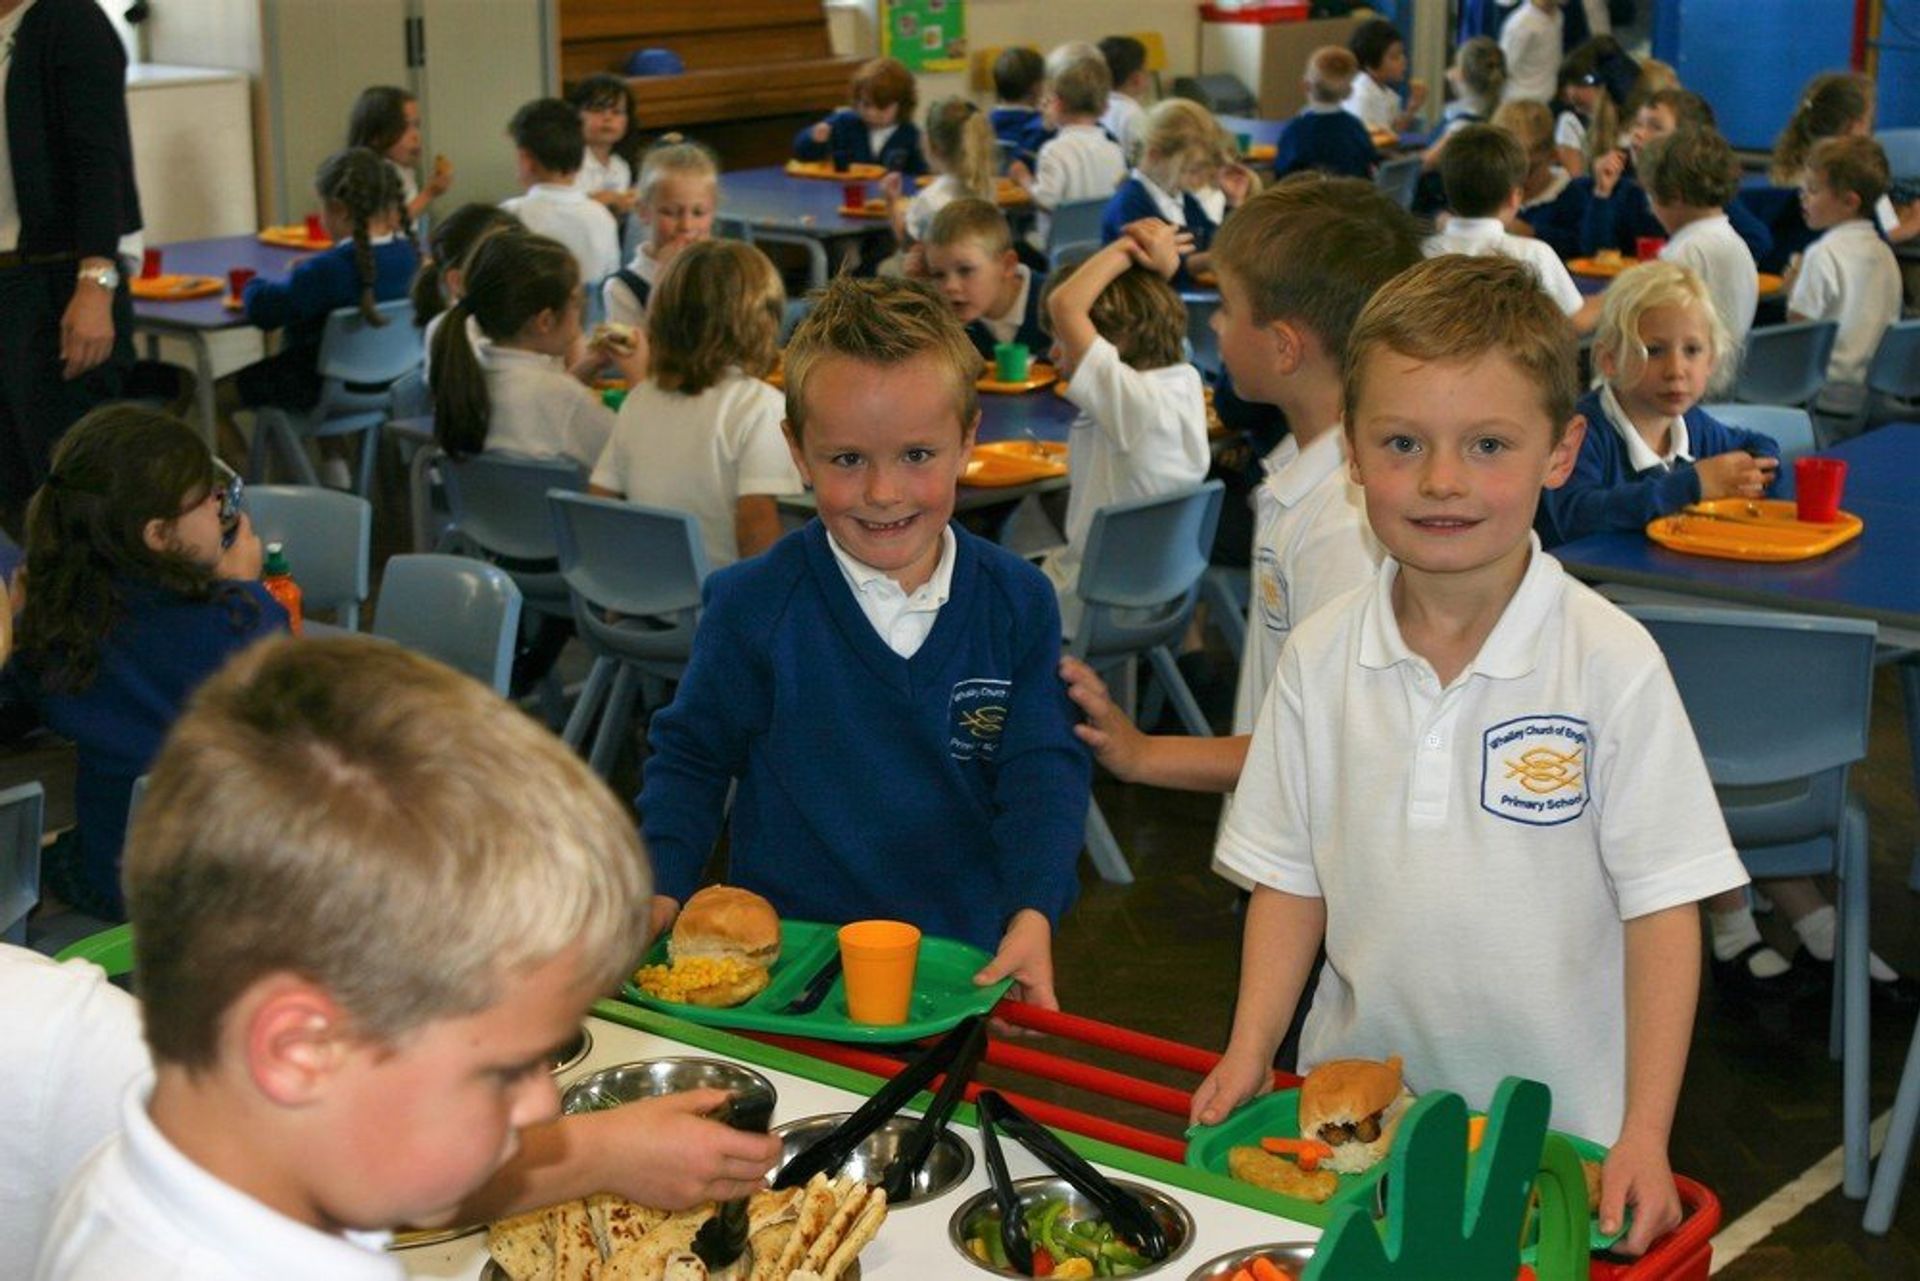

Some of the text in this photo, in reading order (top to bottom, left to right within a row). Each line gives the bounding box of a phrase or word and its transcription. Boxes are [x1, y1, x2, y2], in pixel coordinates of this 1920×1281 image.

[1489, 730, 1523, 748] Whalley
[1526, 724, 1554, 735] Church
[1556, 726, 1565, 736] of
[1502, 794, 1581, 811] Primary School
